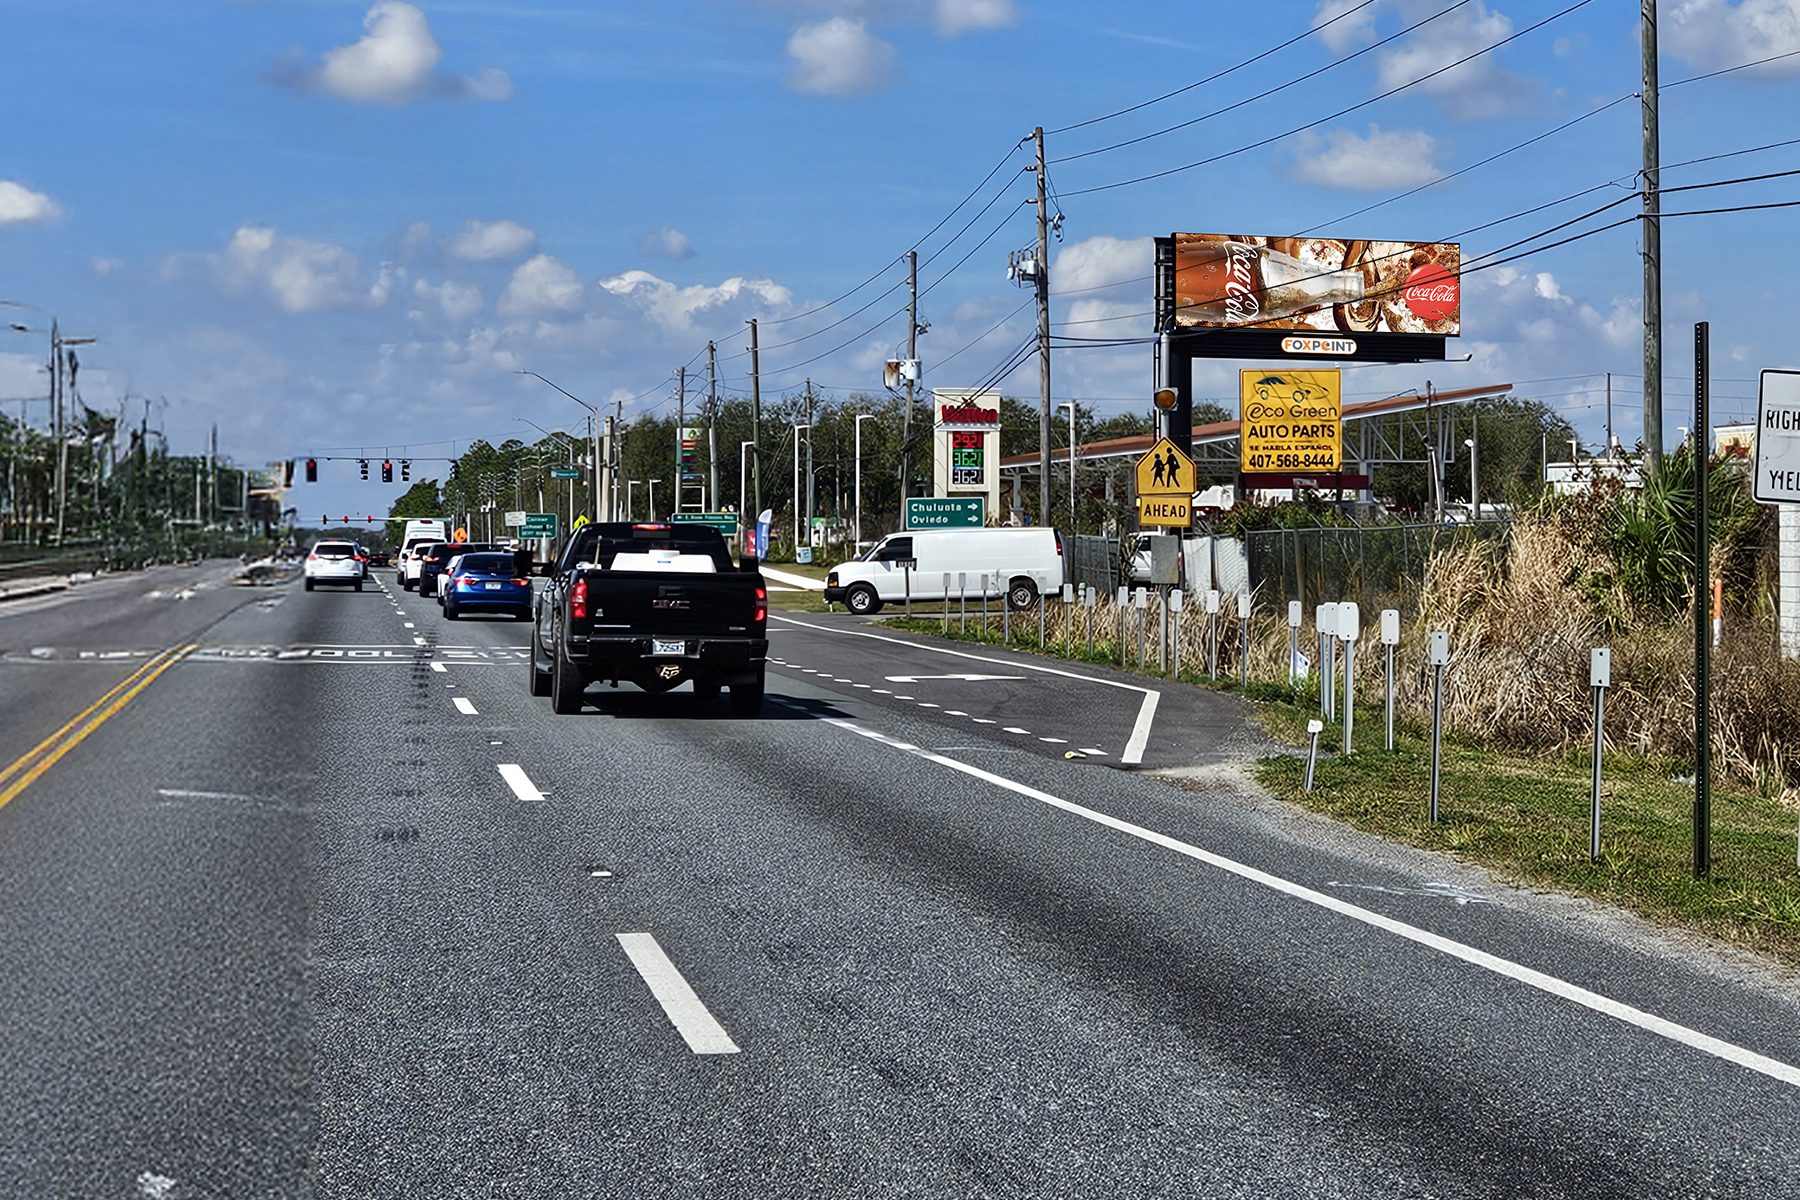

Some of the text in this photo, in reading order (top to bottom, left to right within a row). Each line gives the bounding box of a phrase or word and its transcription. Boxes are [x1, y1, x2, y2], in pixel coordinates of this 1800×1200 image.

[1224, 241, 1259, 322] Coca-Cola
[1405, 284, 1457, 303] Coca-Cola
[1285, 339, 1354, 352] FOXPOINT
[1290, 405, 1337, 418] Green
[1248, 425, 1335, 438] AUTO PARTS
[1144, 504, 1187, 518] AHEAD
[911, 516, 948, 524] Oviedo
